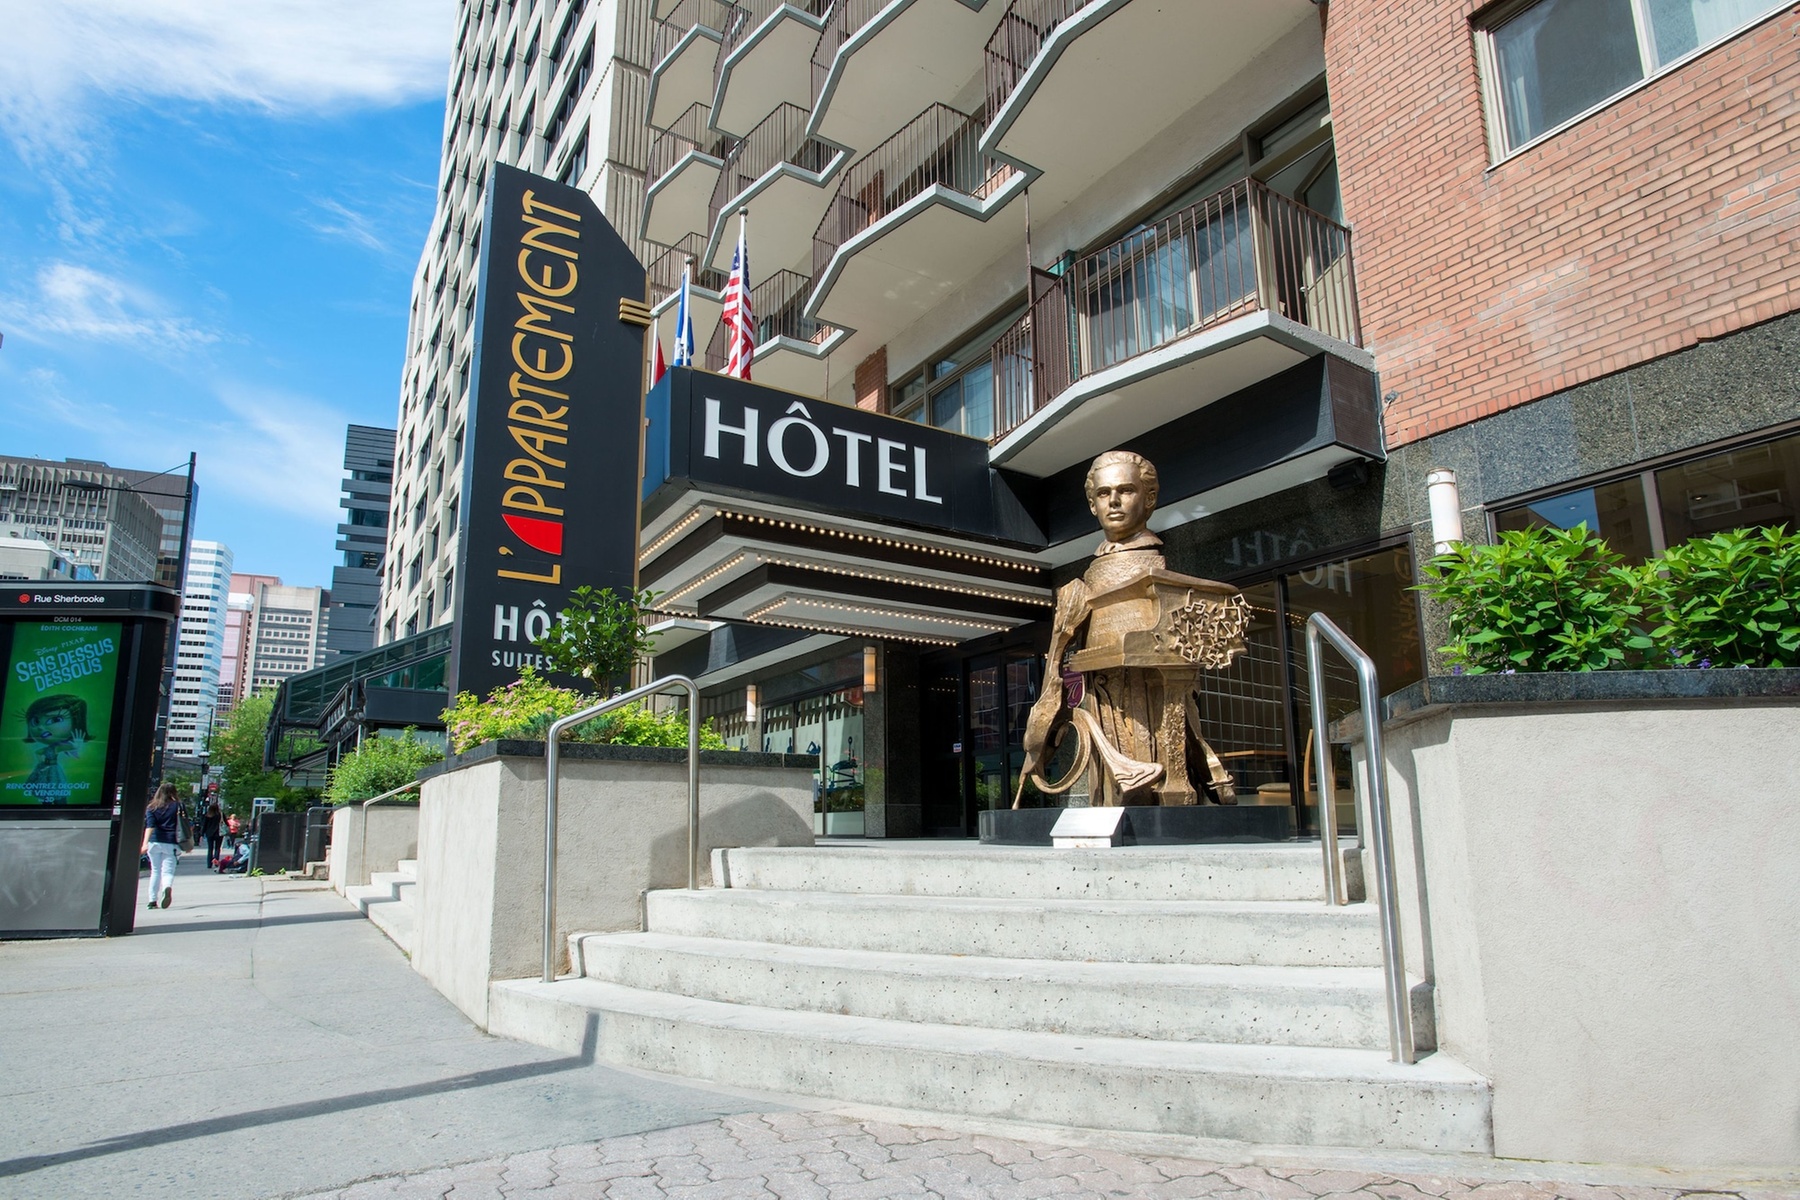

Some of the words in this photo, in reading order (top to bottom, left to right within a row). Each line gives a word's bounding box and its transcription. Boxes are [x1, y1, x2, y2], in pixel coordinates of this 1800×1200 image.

[703, 397, 943, 505] HÔTEL
[33, 594, 52, 603] Rue
[53, 594, 105, 603] Sherbrooke
[40, 624, 60, 632] ÉDITH
[493, 599, 597, 647] HÔT
[61, 637, 85, 649] PIXAR
[15, 655, 57, 682] SENS
[57, 637, 115, 669] DESSUS
[491, 650, 554, 671] SUITES
[34, 657, 103, 693] DESSOUS
[34, 789, 71, 797] VENDREDI
